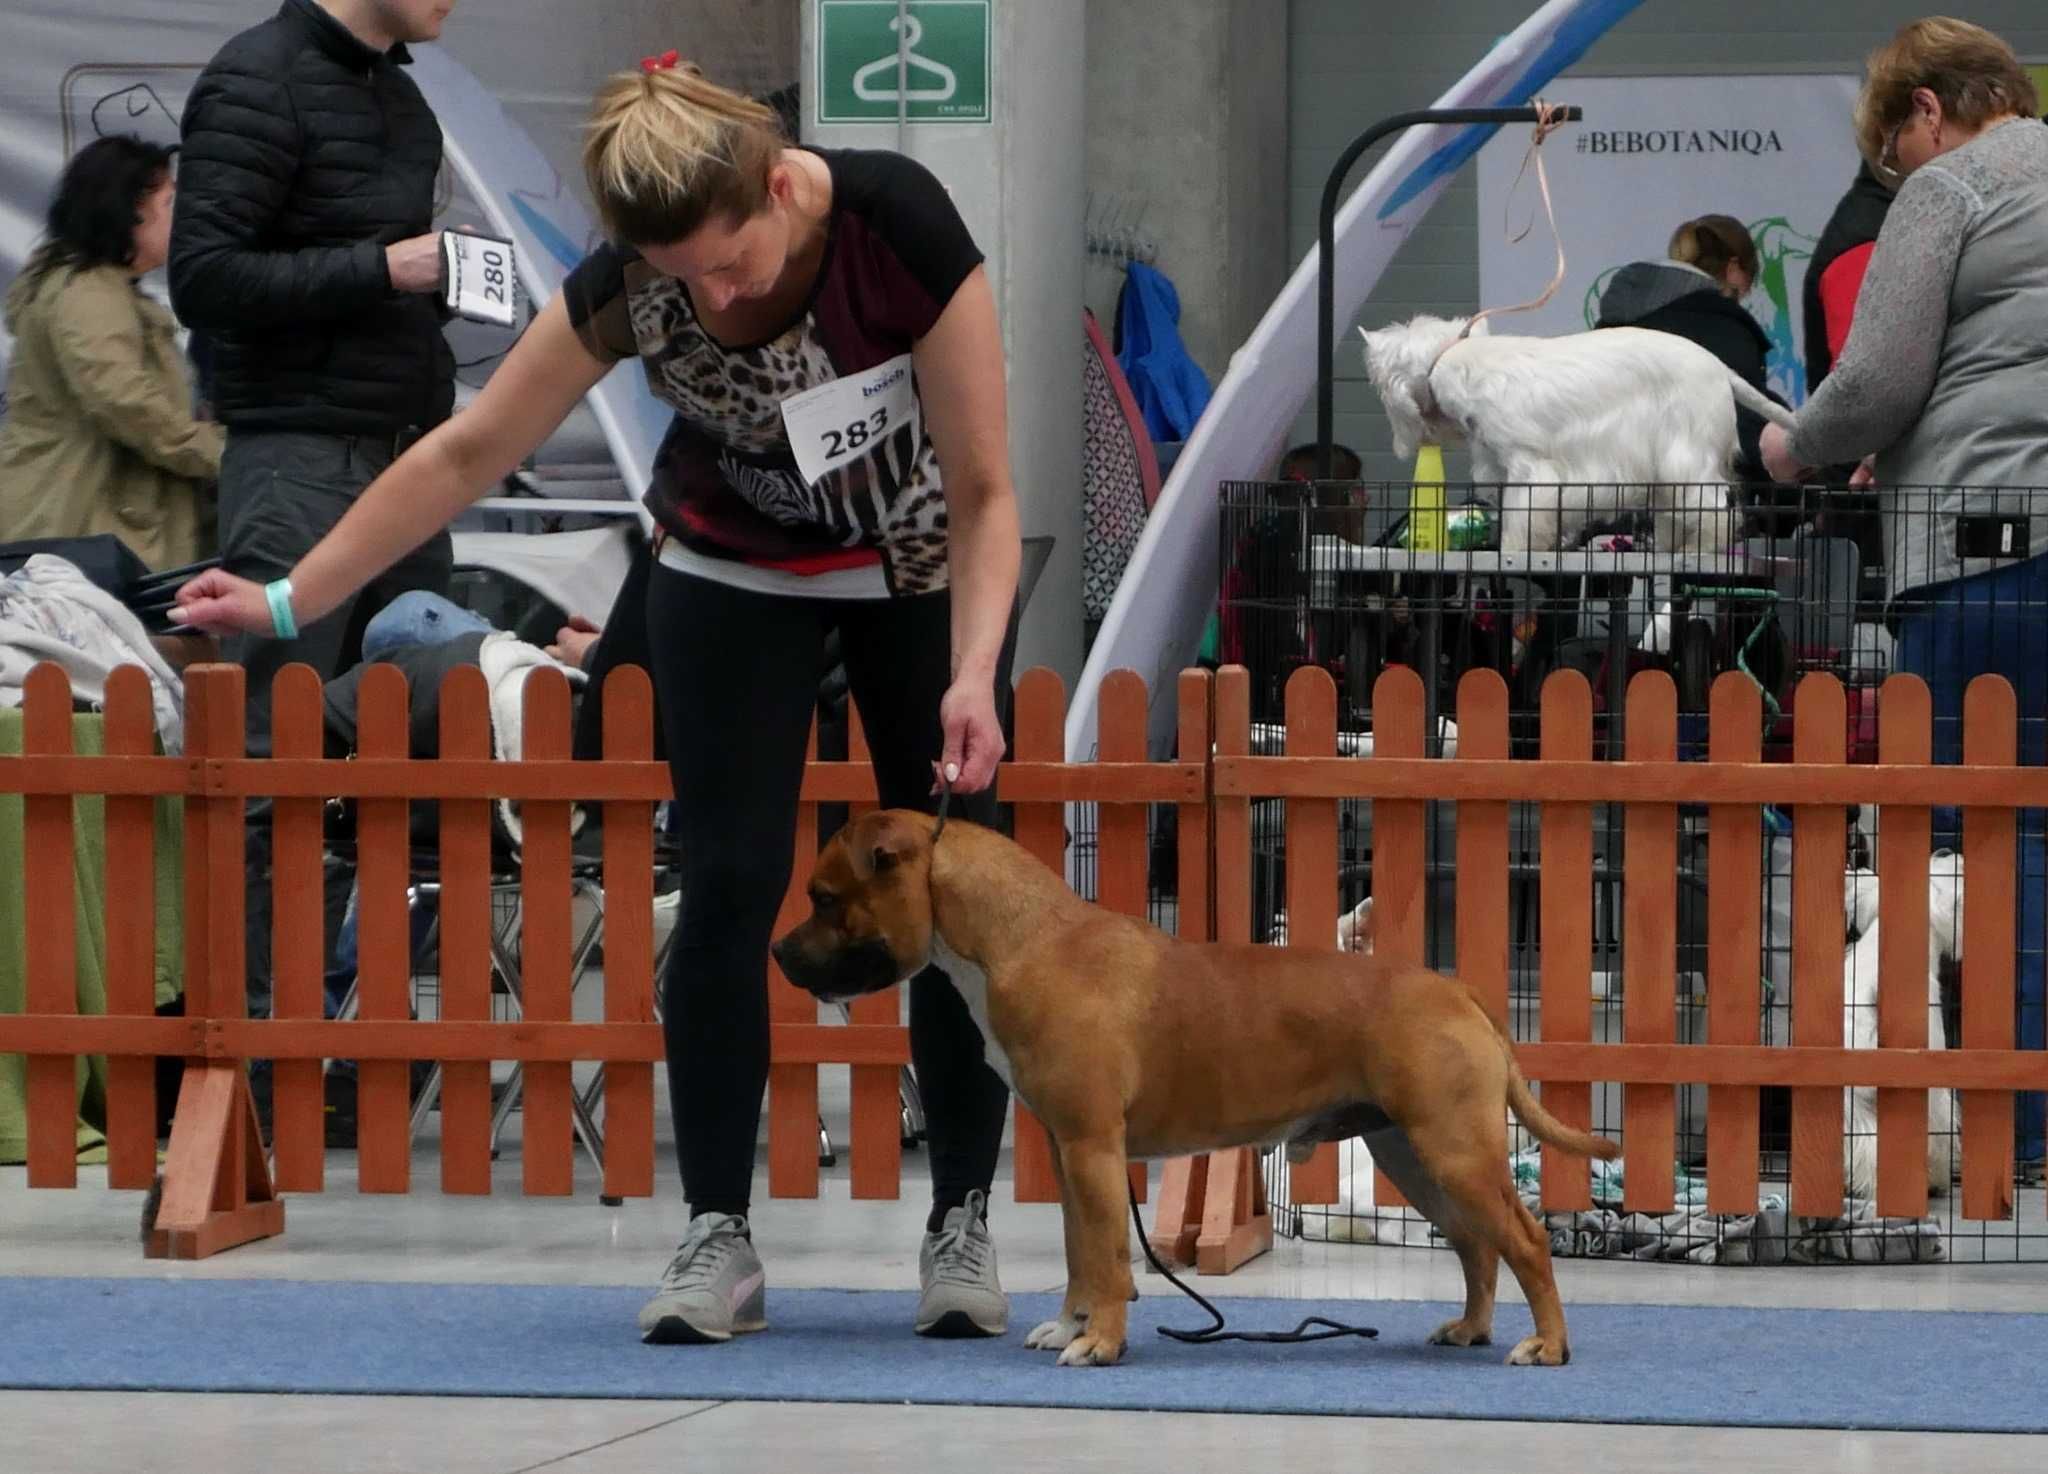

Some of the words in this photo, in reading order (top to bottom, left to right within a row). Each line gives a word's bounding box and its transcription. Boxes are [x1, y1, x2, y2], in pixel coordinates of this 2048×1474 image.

[1576, 129, 1784, 155] #BEBOTANIQA
[483, 250, 504, 304] 280
[821, 406, 888, 460] 283
